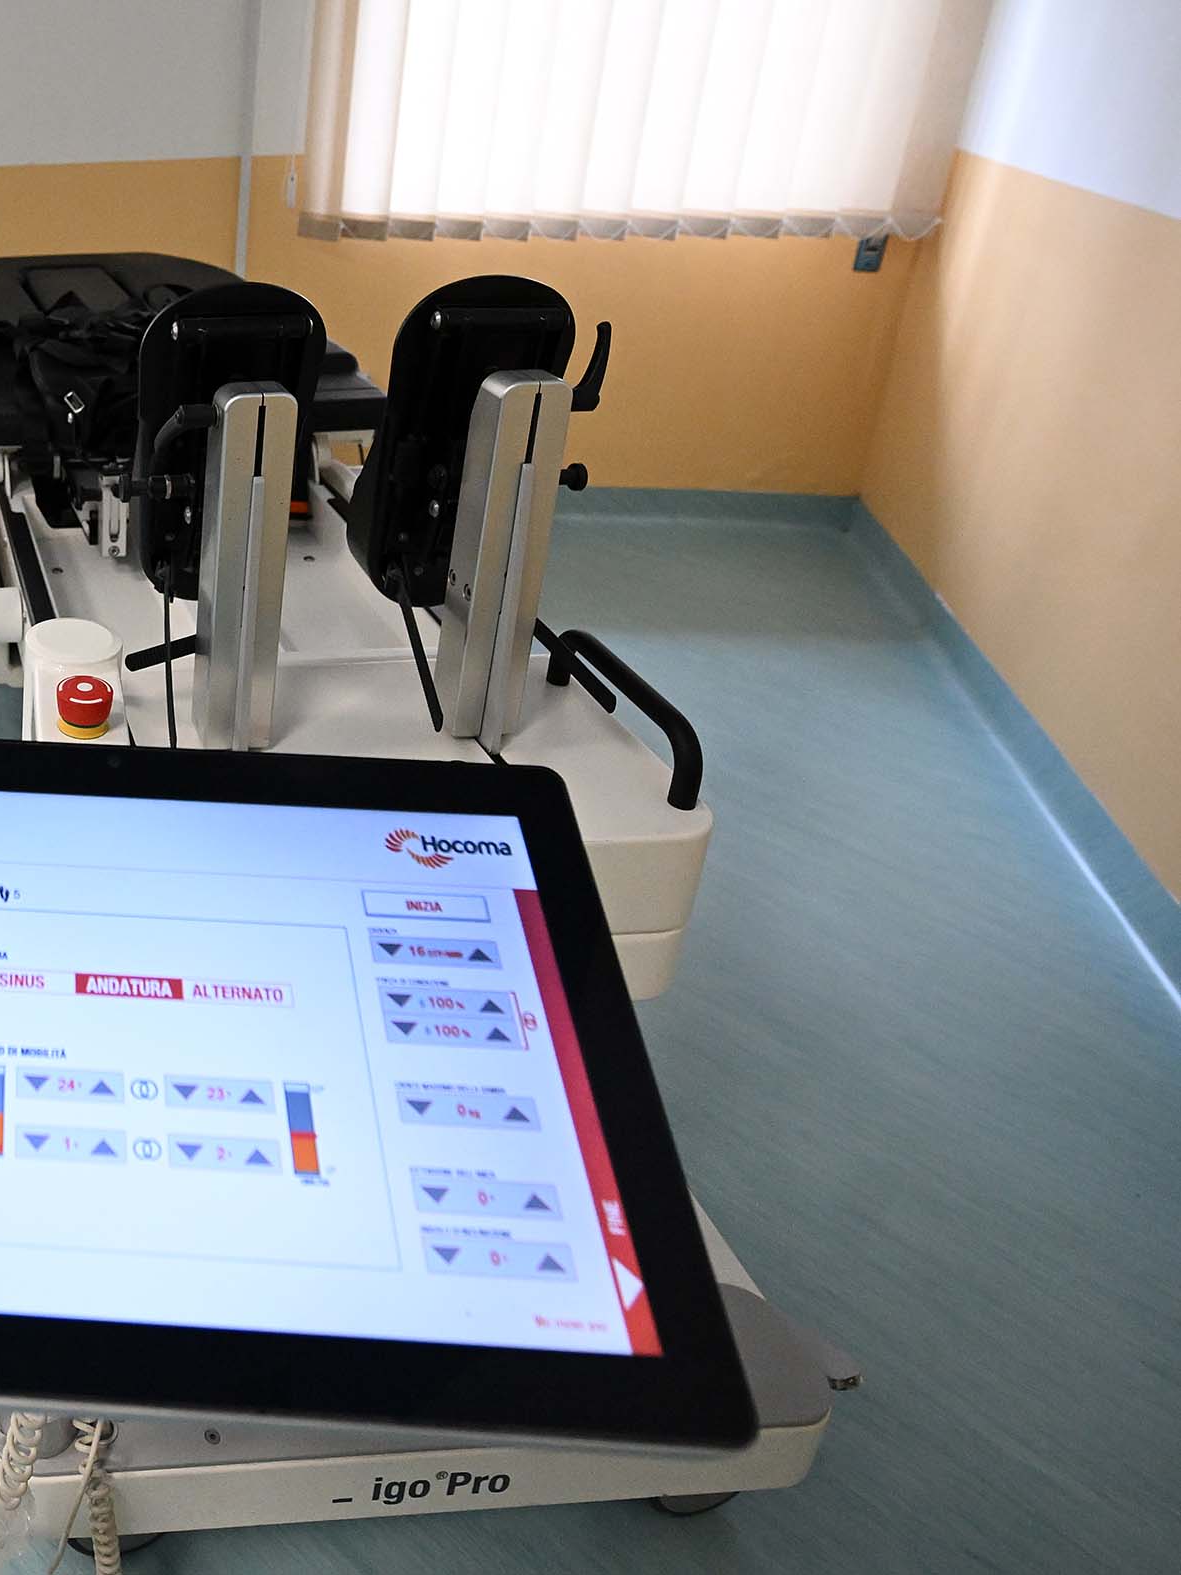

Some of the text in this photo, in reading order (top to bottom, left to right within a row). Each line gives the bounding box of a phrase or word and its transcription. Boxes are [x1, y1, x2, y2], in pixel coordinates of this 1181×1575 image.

[420, 835, 512, 856] Hocoma
[405, 899, 443, 912] INIZIA
[0, 973, 45, 989] SINUS
[85, 976, 173, 998] ANDATURA
[193, 984, 283, 1003] ALTERNATO
[446, 1471, 511, 1496] Pro
